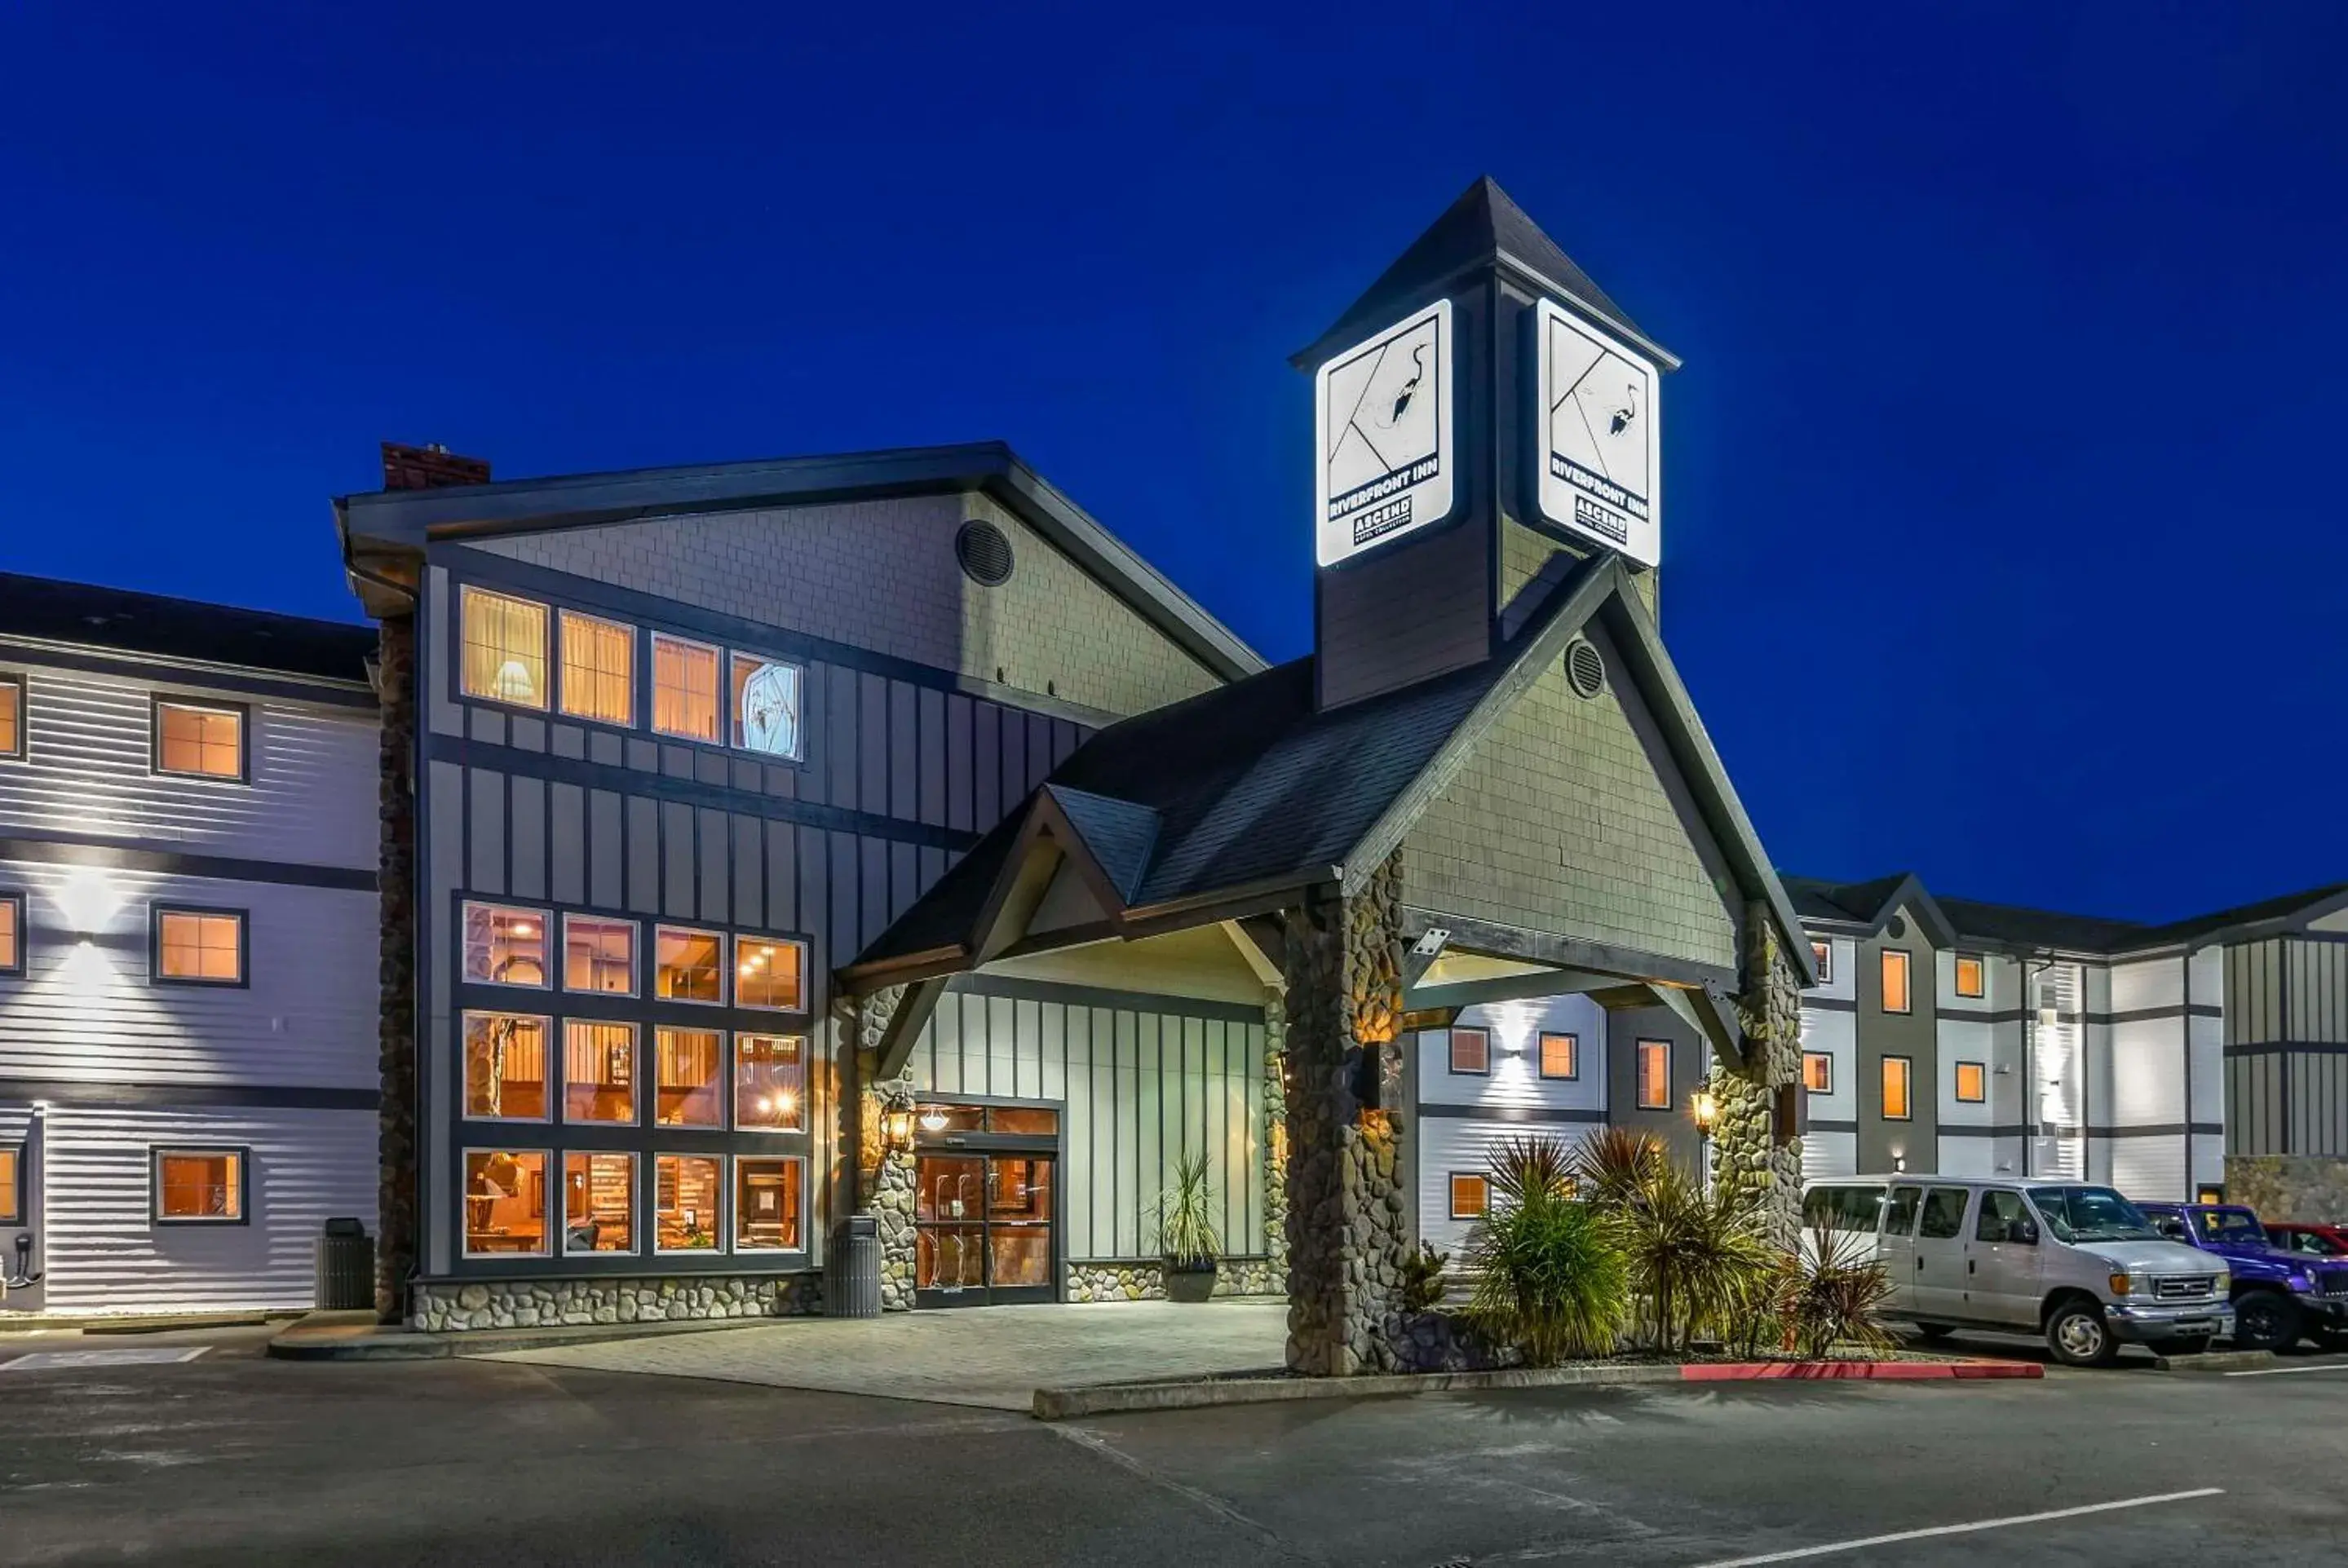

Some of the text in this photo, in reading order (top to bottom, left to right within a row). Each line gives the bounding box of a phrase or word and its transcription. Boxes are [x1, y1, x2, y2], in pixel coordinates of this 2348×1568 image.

[1329, 457, 1437, 518] RIVERFRONT INN
[1552, 457, 1647, 519] RIVERFRONT INN
[1355, 499, 1409, 532] ASCEND
[1577, 498, 1625, 532] ASCEND
